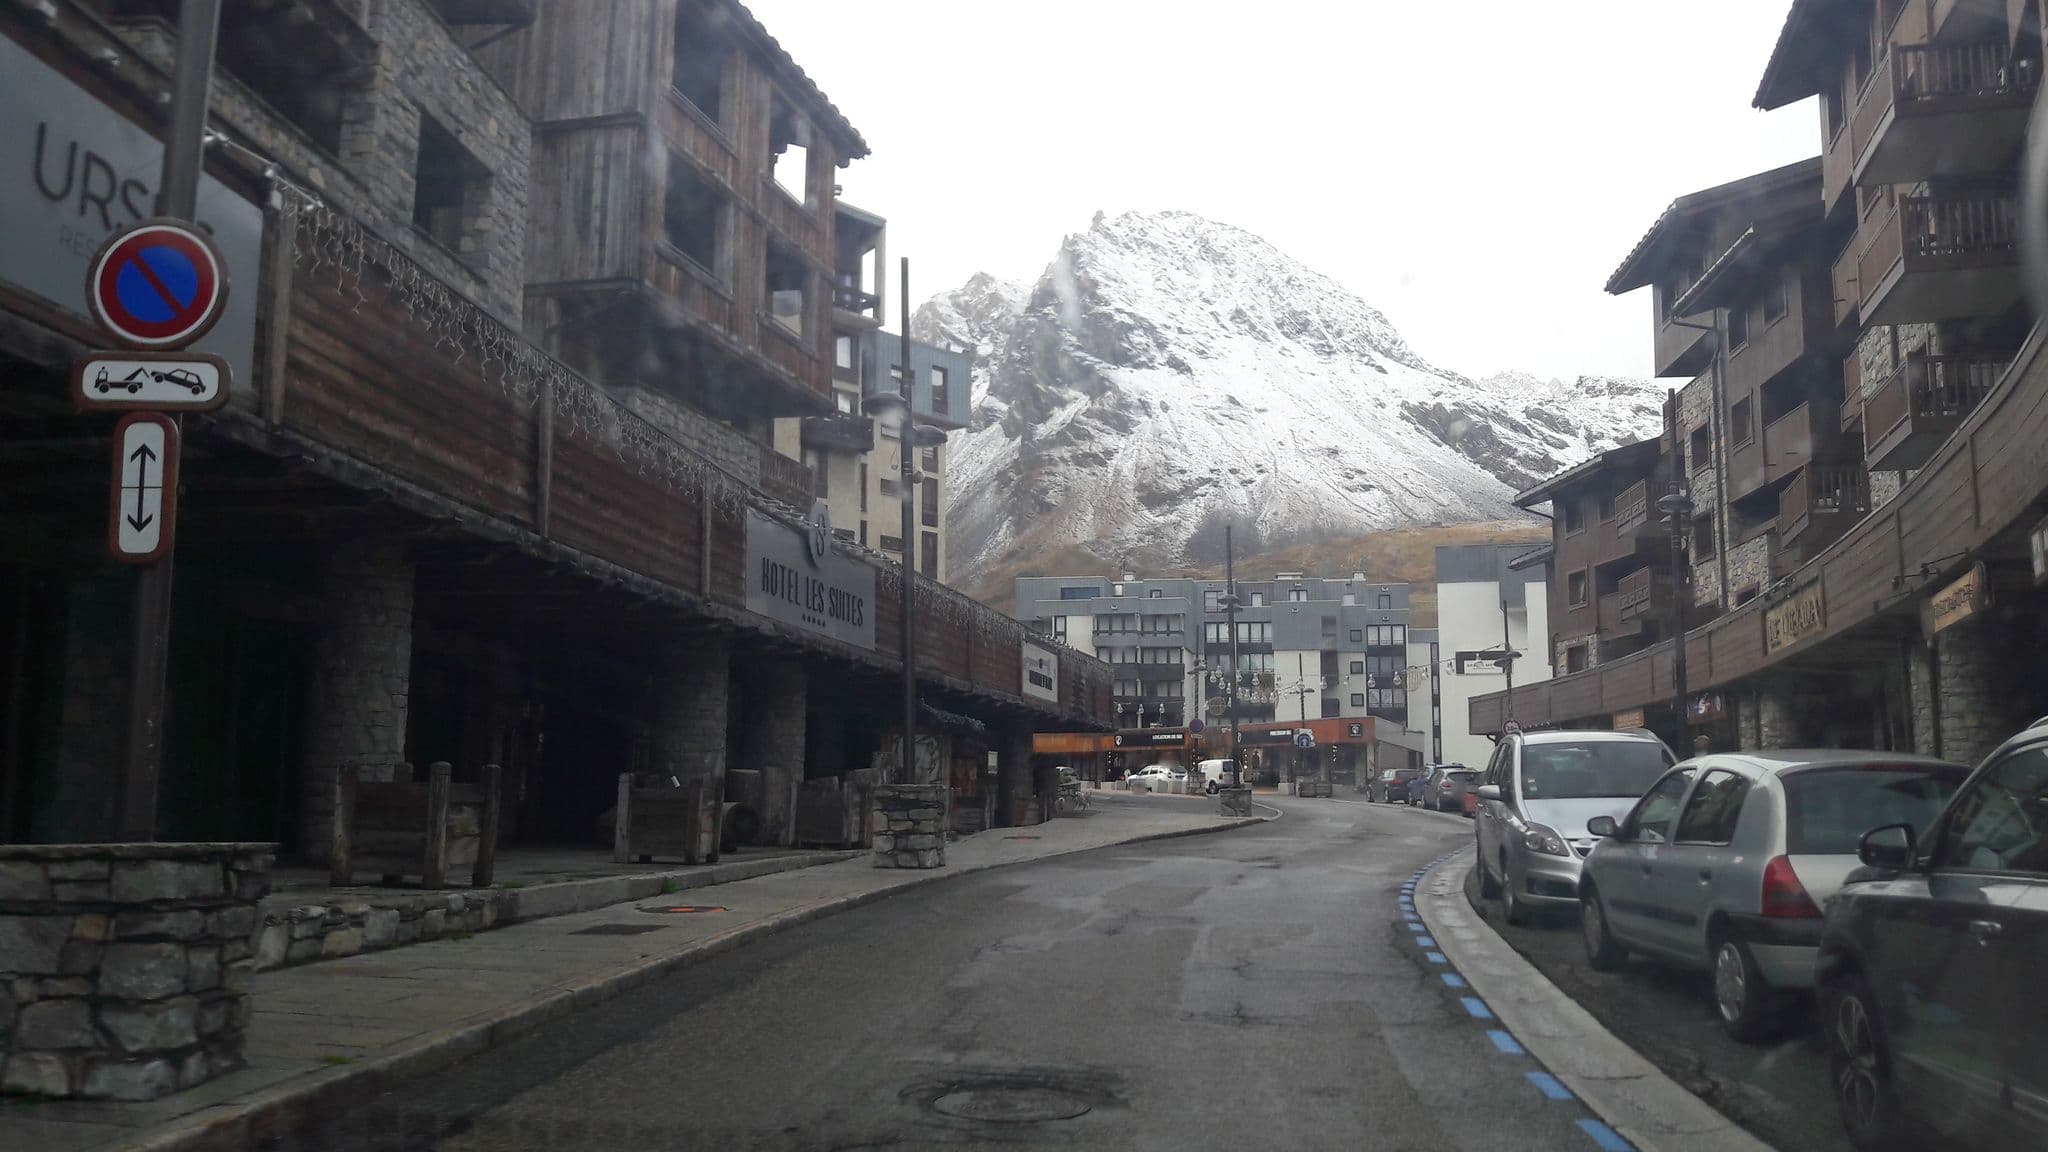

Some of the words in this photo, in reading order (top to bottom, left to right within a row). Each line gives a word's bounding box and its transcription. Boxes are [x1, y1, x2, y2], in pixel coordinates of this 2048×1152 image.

[761, 556, 801, 606] HOTEL
[806, 575, 825, 614] LES
[828, 586, 864, 628] SUITES
